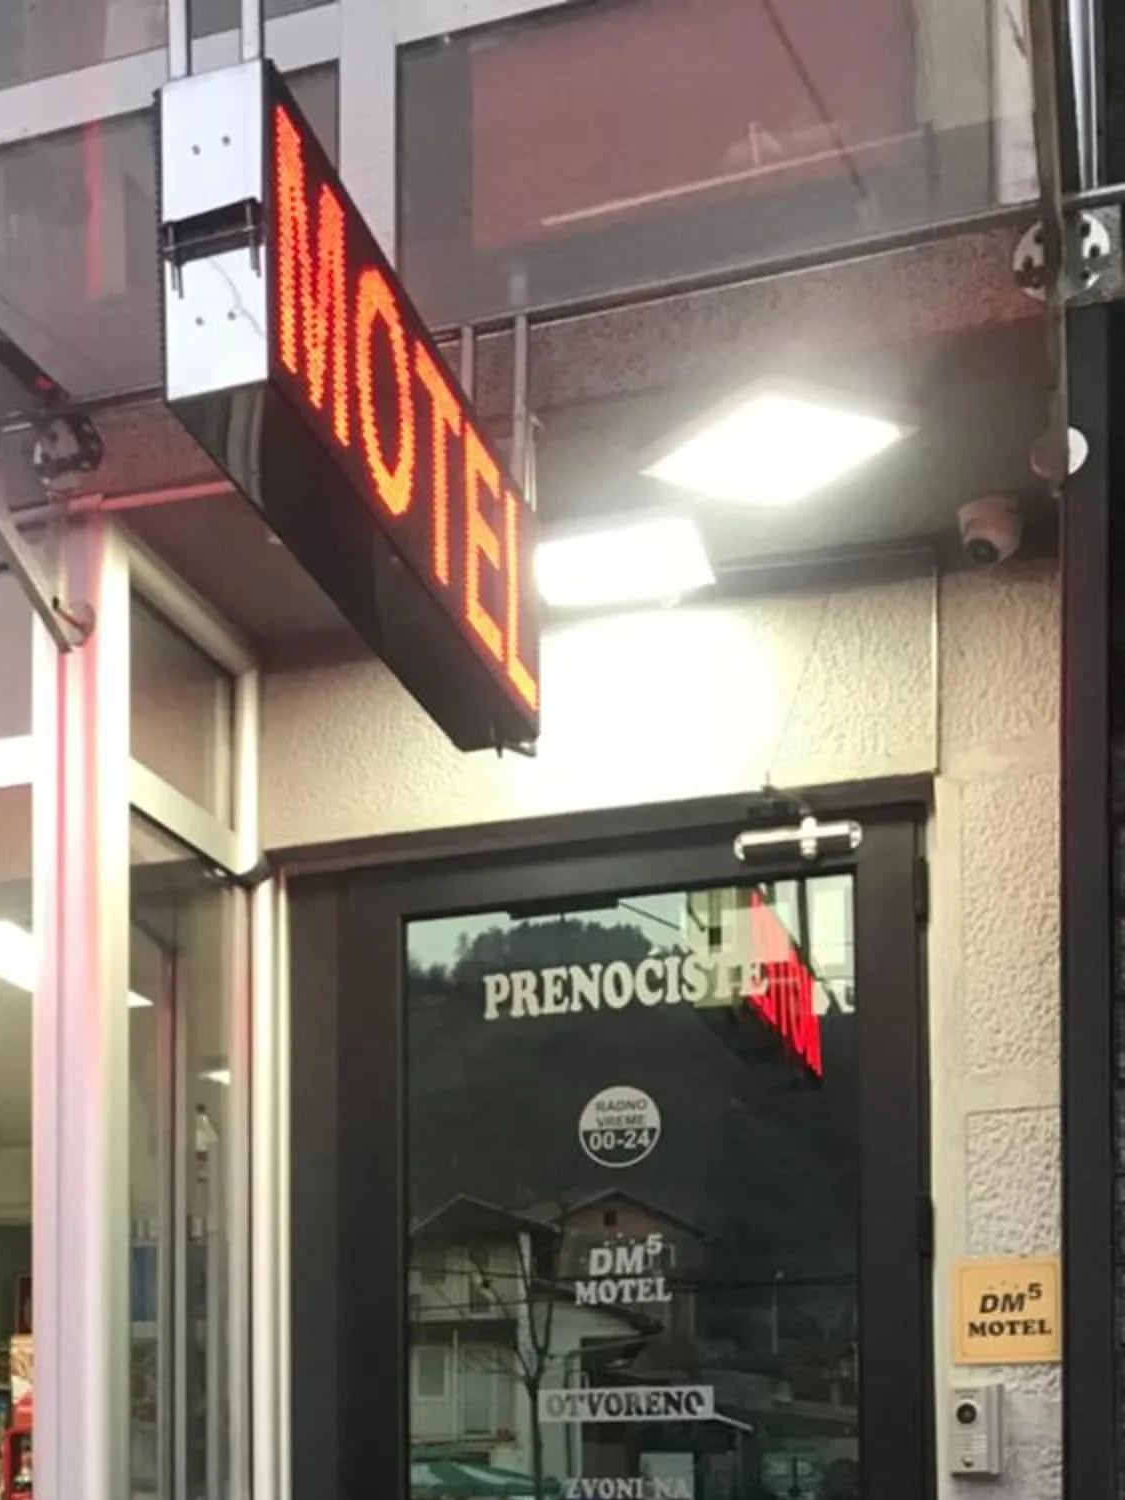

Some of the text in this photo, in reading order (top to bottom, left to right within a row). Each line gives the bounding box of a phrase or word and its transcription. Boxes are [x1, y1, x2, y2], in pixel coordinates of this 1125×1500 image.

[275, 104, 538, 712] MOTEL
[589, 1129, 650, 1151] 00-24
[575, 1276, 673, 1305] MOTEL
[967, 1318, 1053, 1338] MOTEL
[545, 1390, 706, 1417] OTVORENO
[566, 1477, 643, 1500] ZVONI
